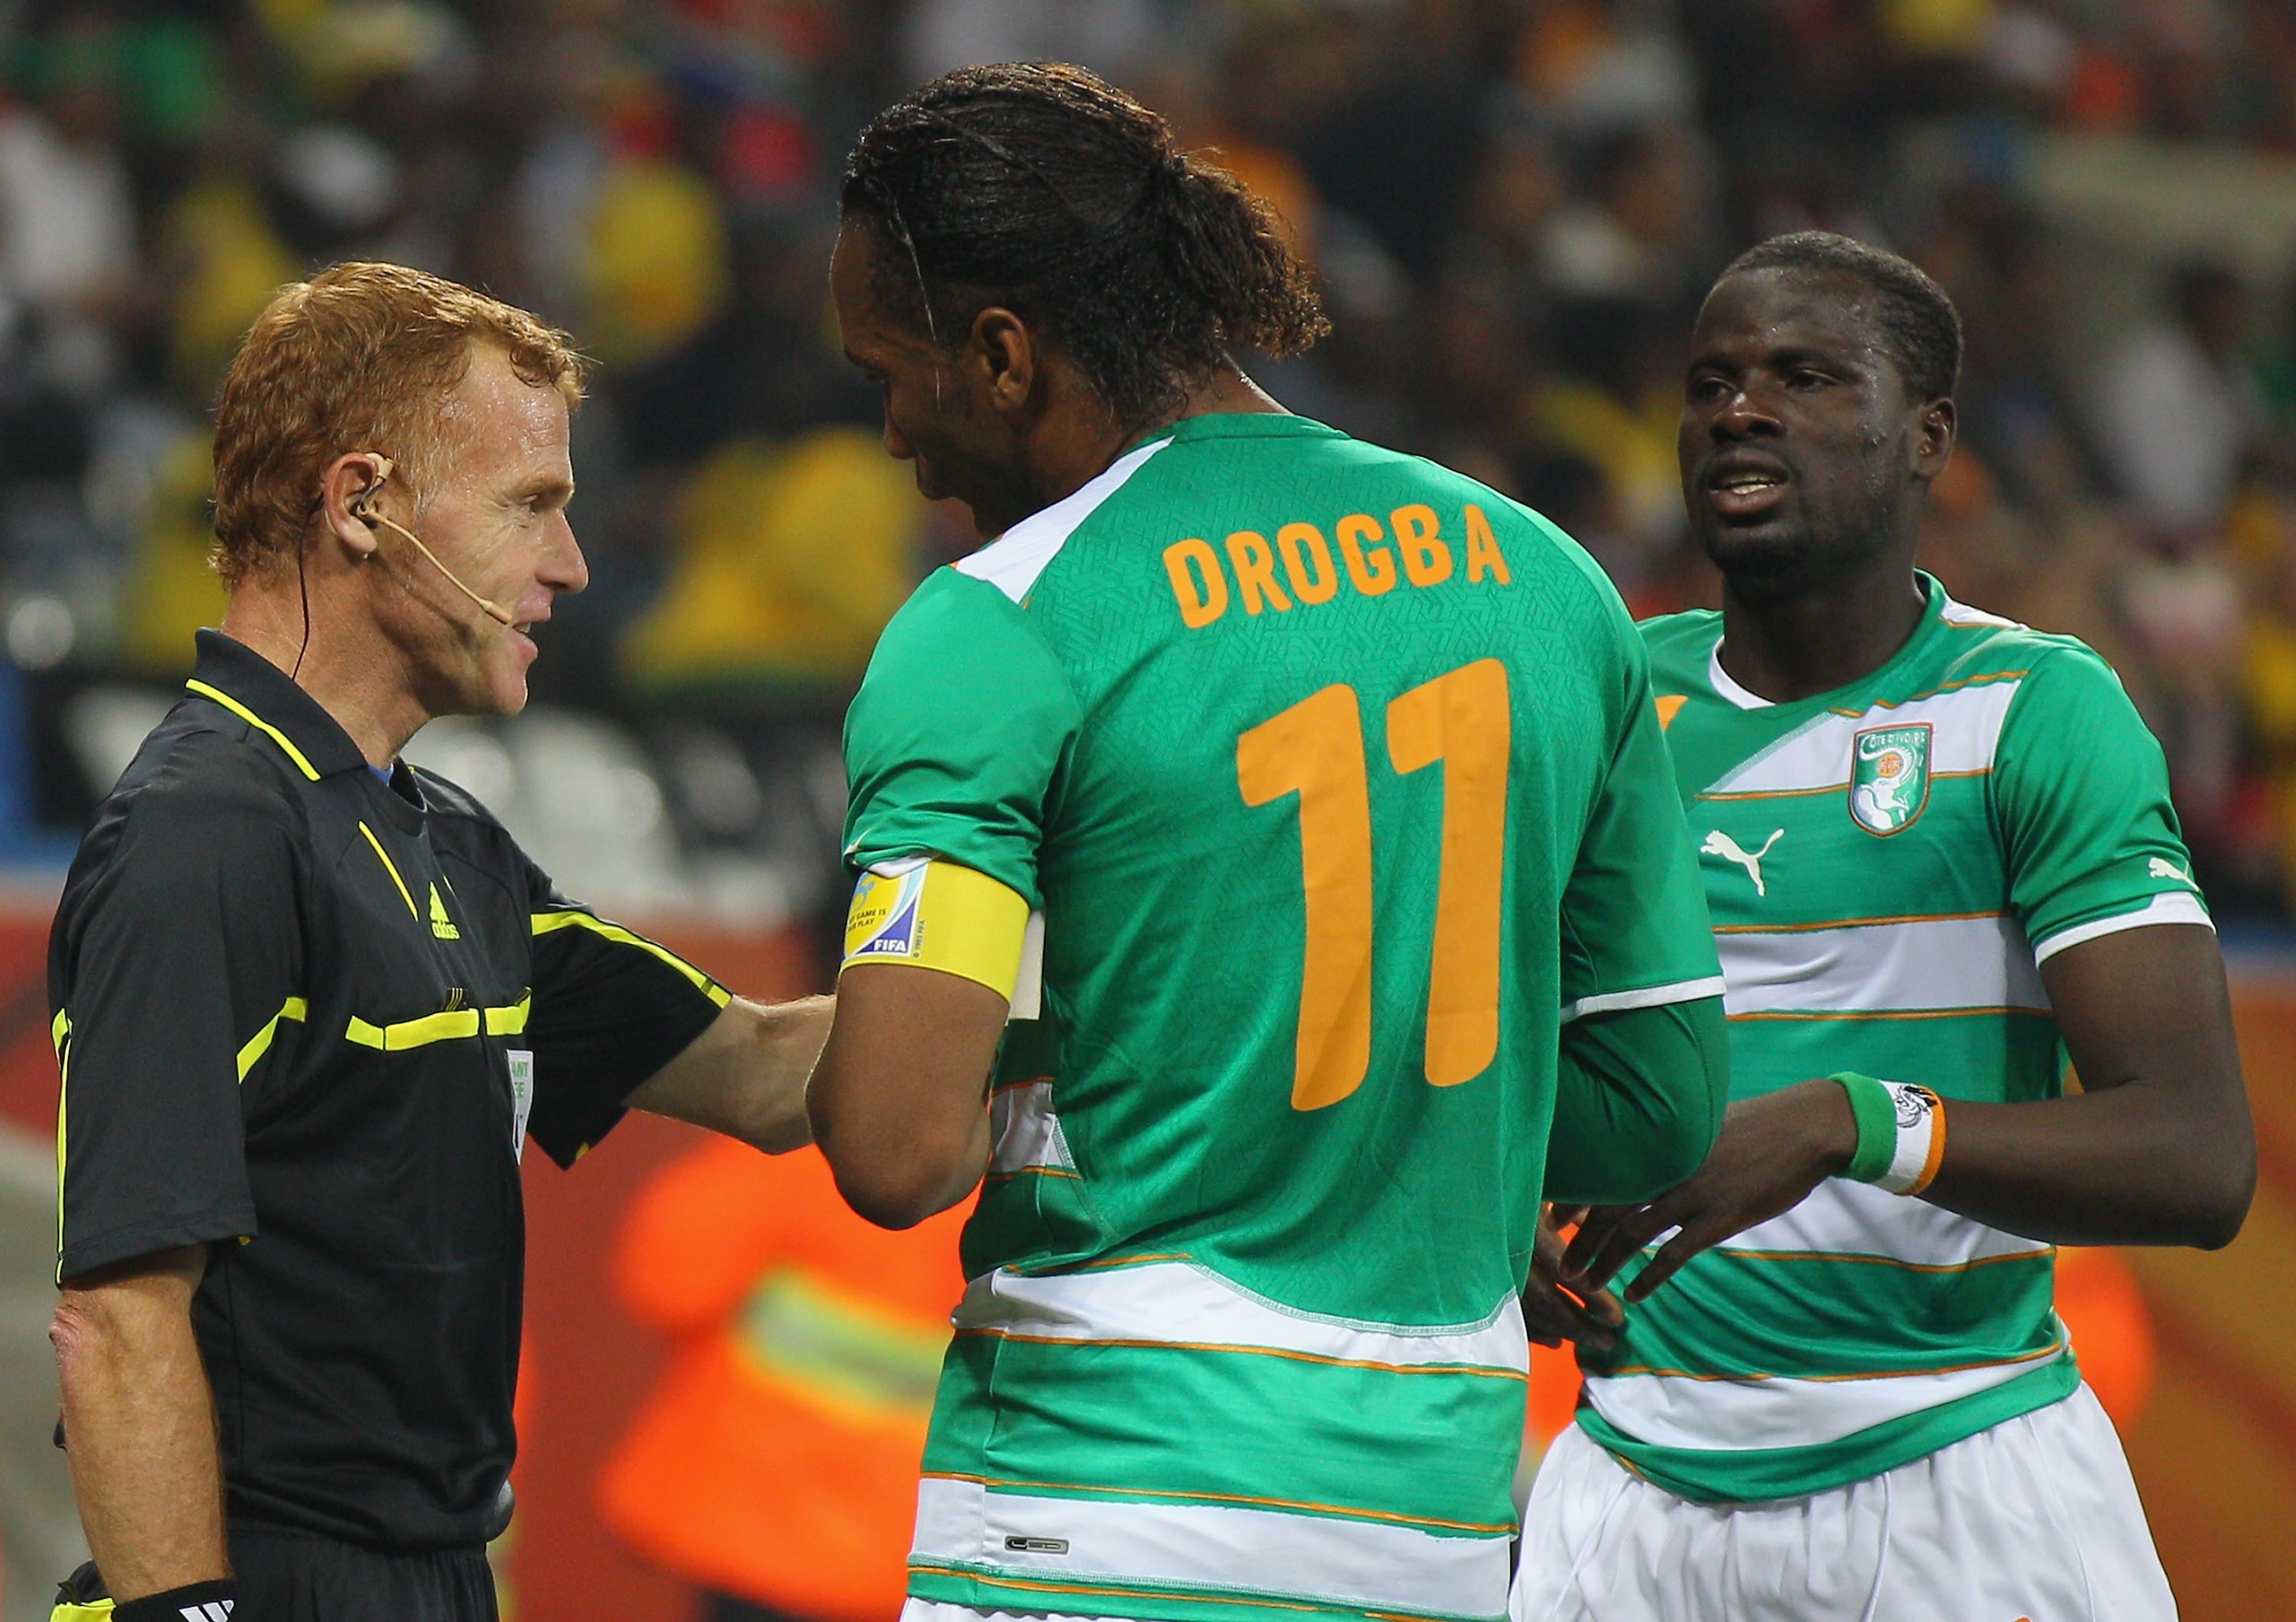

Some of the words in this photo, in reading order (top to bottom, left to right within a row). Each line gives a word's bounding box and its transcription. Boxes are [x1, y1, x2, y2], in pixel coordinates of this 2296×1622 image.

[1162, 503, 1511, 629] DROGBA
[874, 939, 907, 951] FIFA
[1237, 658, 1511, 1112] 11
